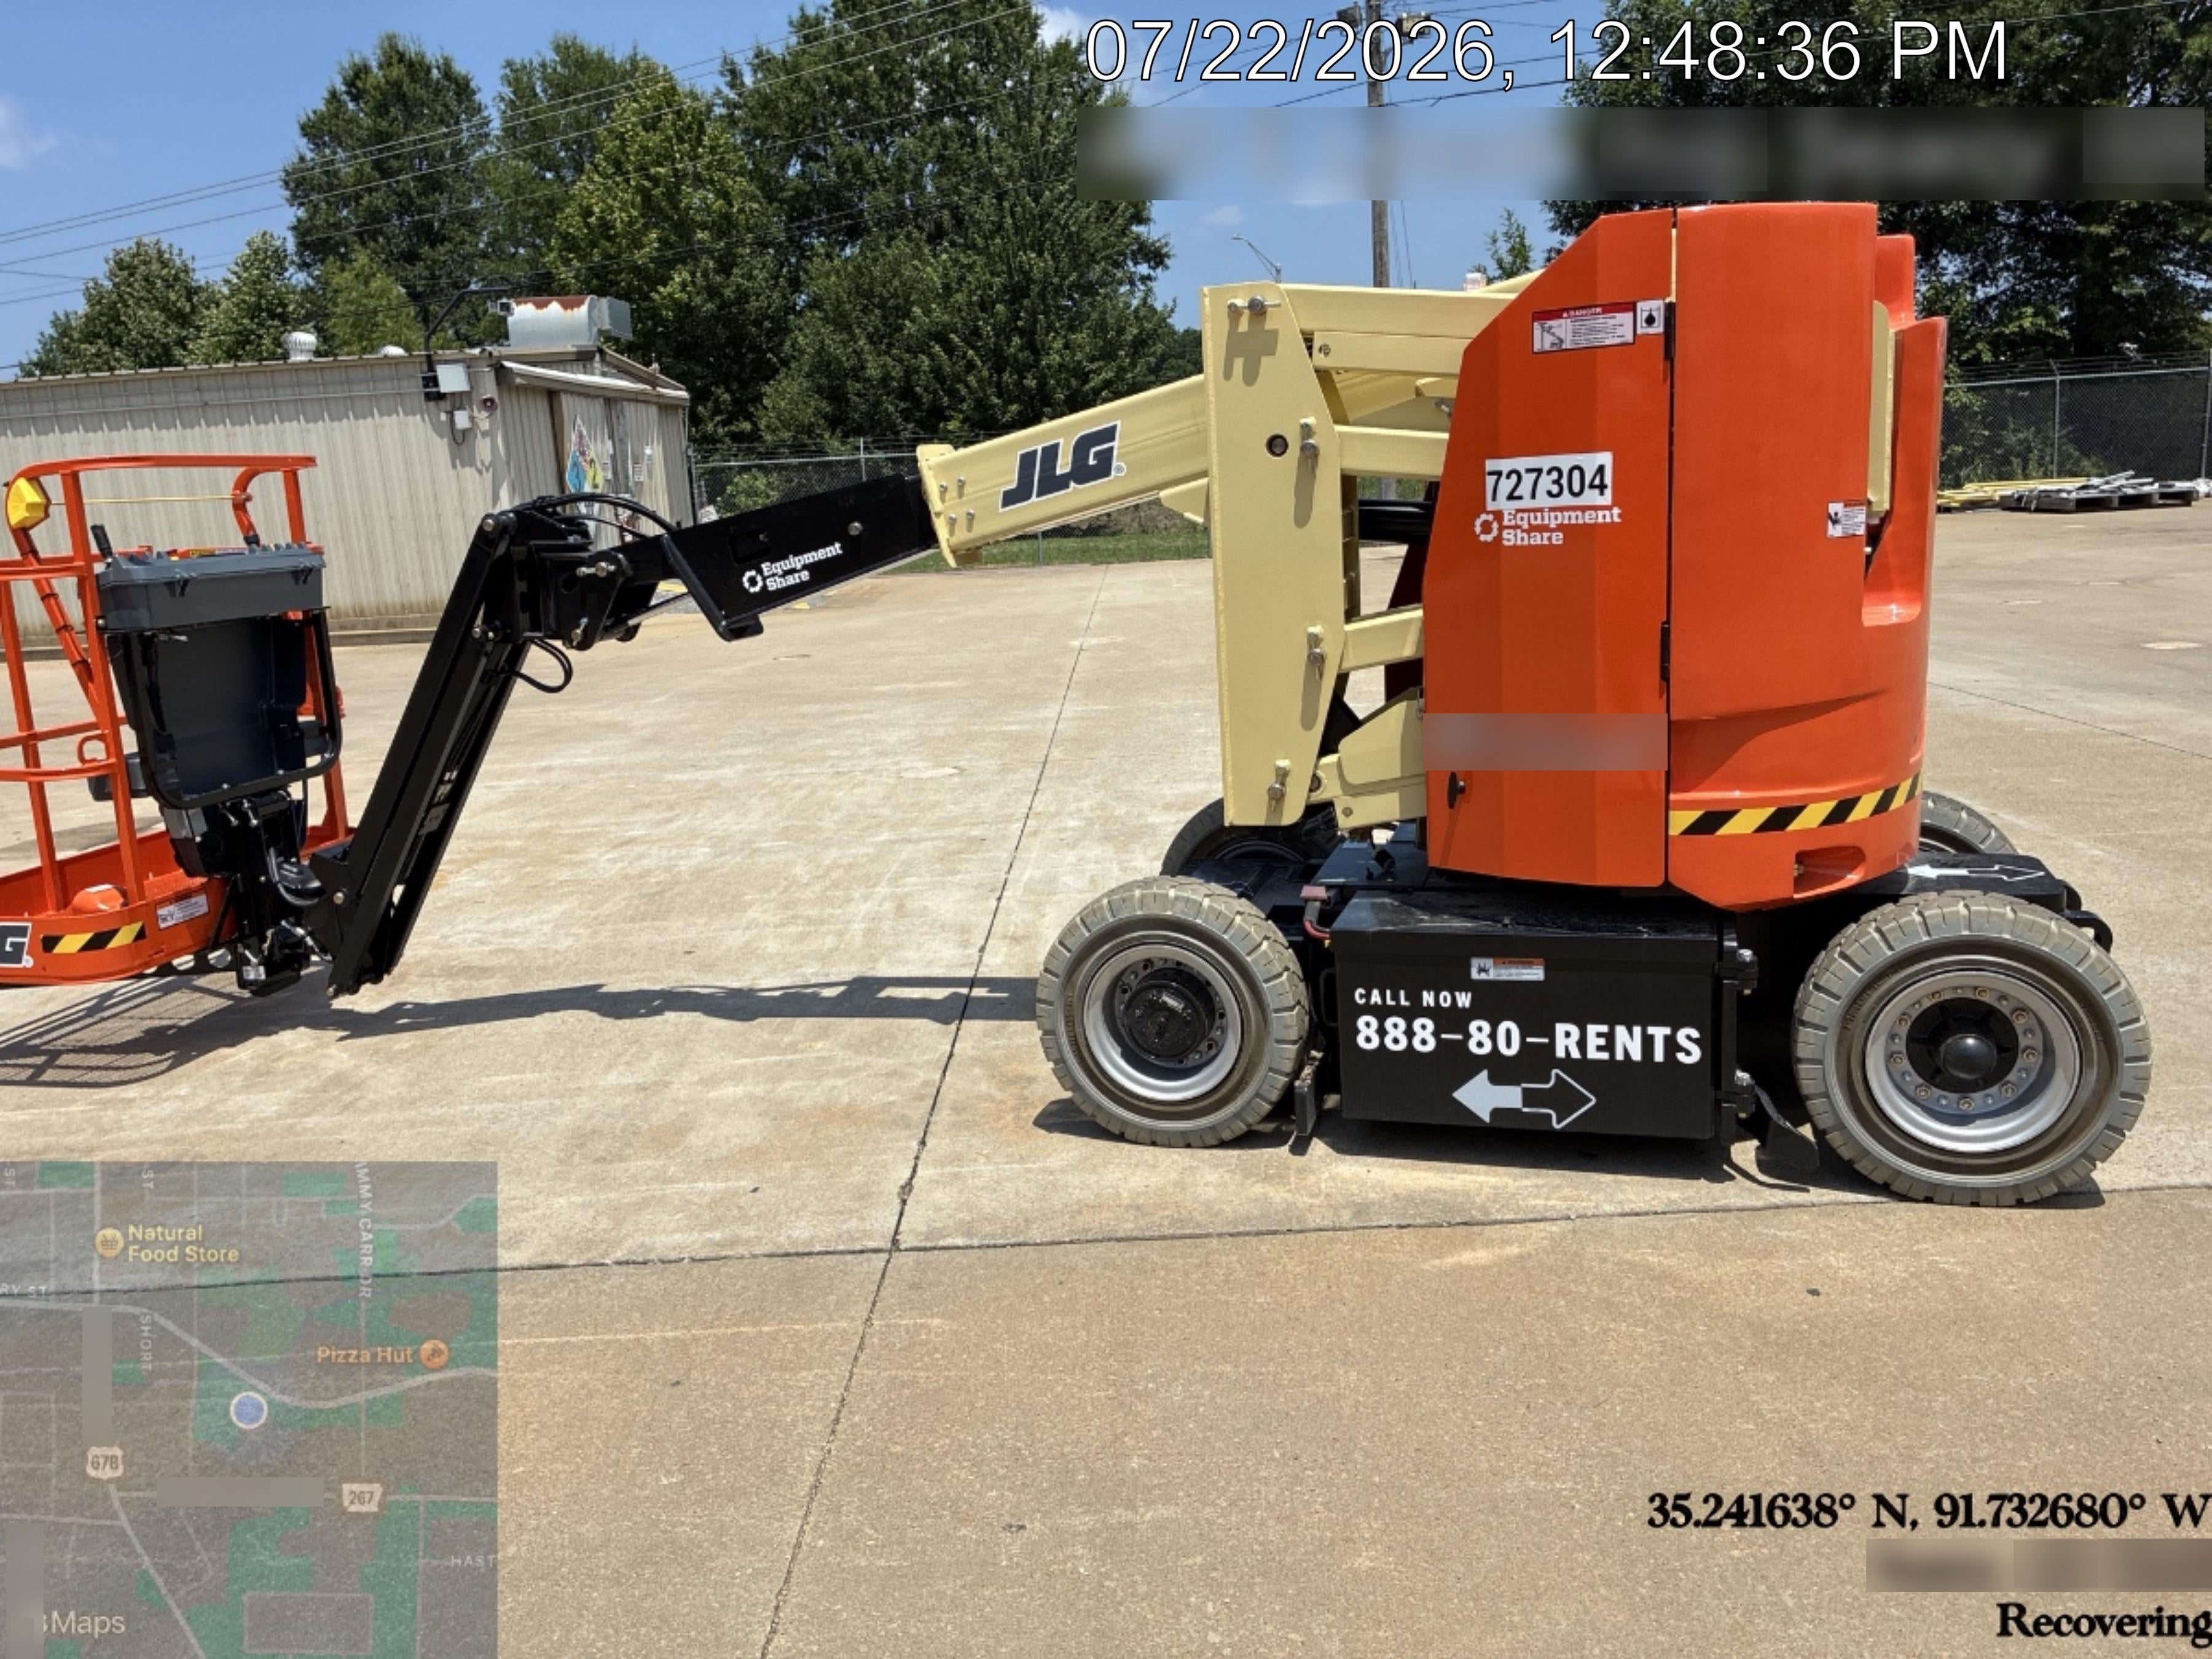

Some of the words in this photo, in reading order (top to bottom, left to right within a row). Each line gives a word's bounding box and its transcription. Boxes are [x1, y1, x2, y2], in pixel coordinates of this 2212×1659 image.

[999, 420, 1121, 512] JLG
[1486, 464, 1608, 502] 727304
[1502, 506, 1622, 528] Equipment
[1502, 529, 1564, 546] Share
[761, 541, 843, 576] Equipment
[766, 570, 810, 590] Share
[1354, 988, 1411, 1006] CALL
[1422, 990, 1472, 1009] NOW
[1355, 1015, 1702, 1064] 888-80-RENTS
